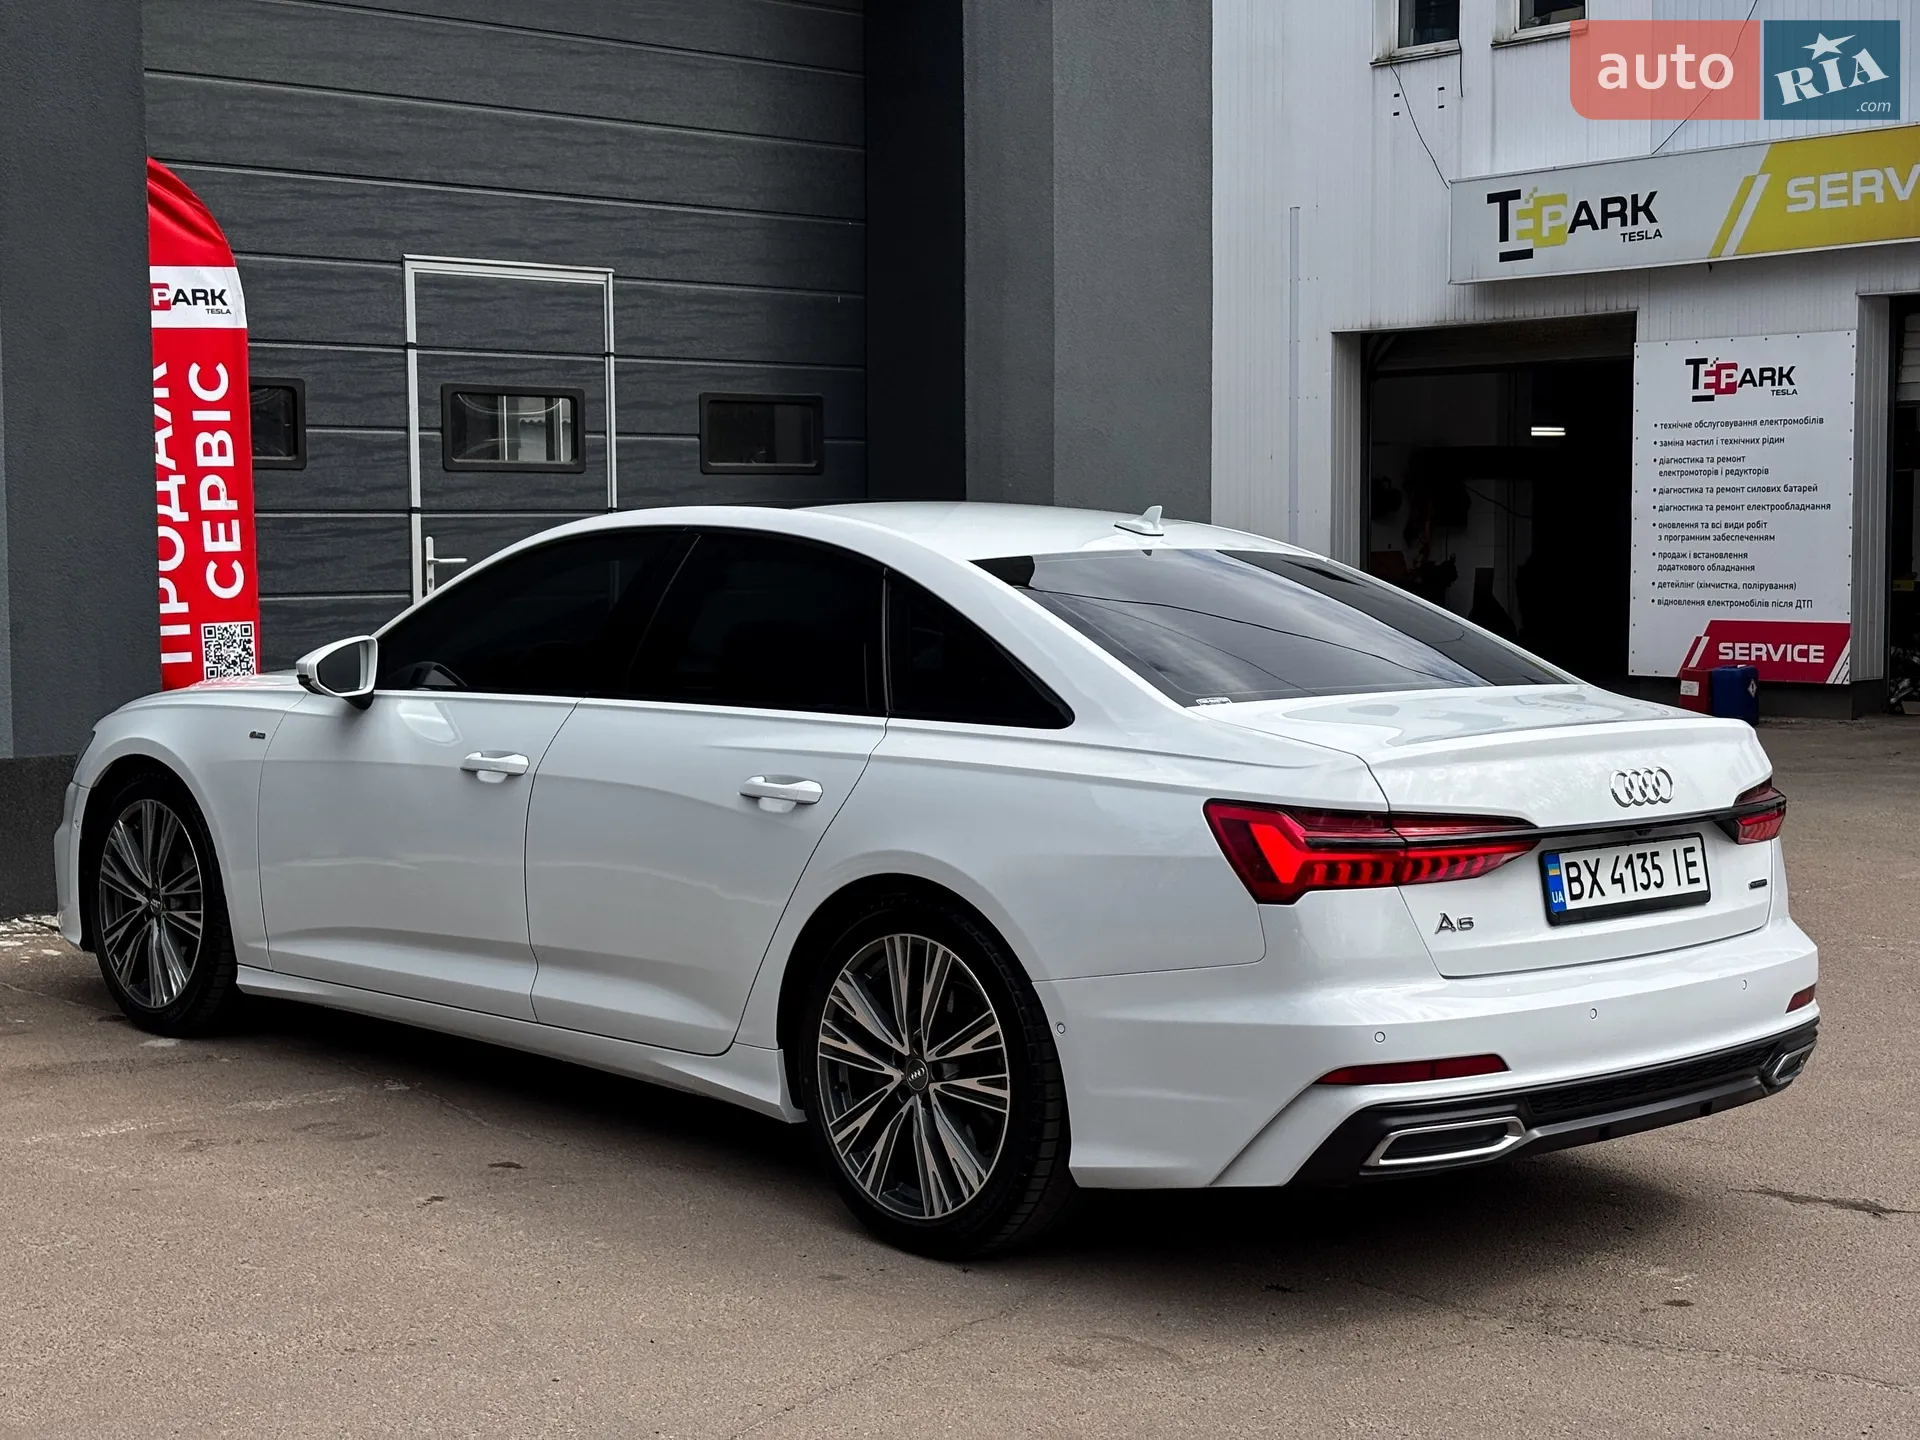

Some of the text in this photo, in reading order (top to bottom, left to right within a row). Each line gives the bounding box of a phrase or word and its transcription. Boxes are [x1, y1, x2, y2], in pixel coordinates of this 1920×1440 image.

[1620, 229, 1663, 243] TESLA
[1660, 416, 1824, 430] технічне обслуговування електромобілів
[1659, 439, 1684, 447] заміна
[1686, 438, 1714, 446] мастил
[1720, 436, 1760, 445] технічних
[1762, 435, 1785, 445] рідин
[1659, 456, 1704, 465] діагностика
[1717, 456, 1746, 465] ремонт
[1659, 467, 1718, 478] електромоторів
[1725, 466, 1769, 476] редукторів
[188, 362, 245, 599] СЕРВІС
[1658, 486, 1703, 495] діагностика
[1716, 486, 1745, 495] ремонт
[1747, 485, 1781, 493] силових
[1783, 484, 1818, 493] батарей
[1658, 503, 1703, 513] діагностика
[1715, 503, 1745, 513] ремонт
[1747, 502, 1831, 512] електрообладнання
[1724, 521, 1744, 529] види
[1747, 520, 1768, 530] робіт
[1664, 534, 1710, 543] програмним
[1713, 533, 1775, 542] забеспеченням
[1658, 552, 1687, 560] продаж
[1658, 563, 1755, 572] додаткового обладнання
[1657, 581, 1694, 589] детейлінг
[1742, 581, 1796, 591] полірування)
[1657, 598, 1813, 609] відновлення електромобілів після ДТП
[1718, 642, 1824, 663] SERVICE
[1565, 857, 1605, 901] BX
[1611, 851, 1664, 894] 4135
[1552, 891, 1564, 904] UA
[1435, 913, 1474, 934] A6
